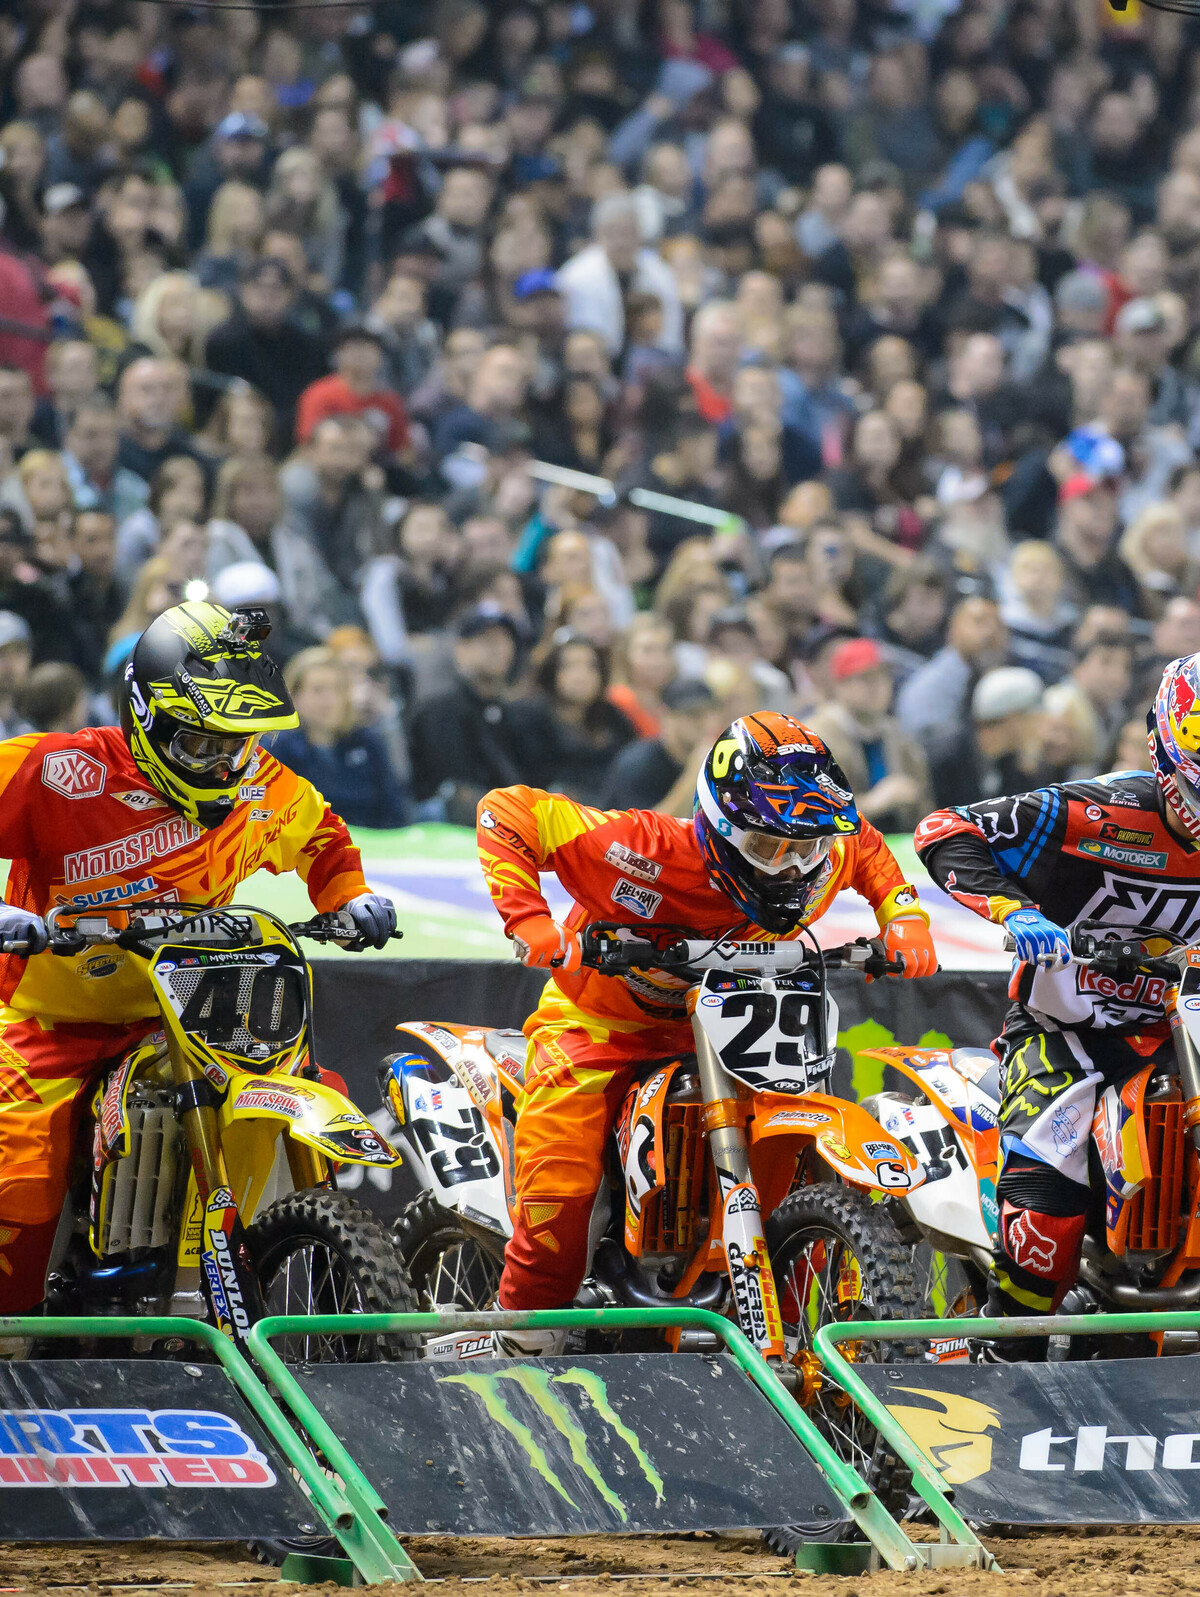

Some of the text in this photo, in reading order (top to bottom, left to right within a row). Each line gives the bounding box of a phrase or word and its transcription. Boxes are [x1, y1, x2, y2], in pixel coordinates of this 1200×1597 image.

[122, 791, 153, 806] BOLT
[1109, 799, 1141, 809] RENTHAL
[1103, 846, 1161, 867] MOTOREX
[73, 877, 154, 908] SUZUKI
[180, 967, 305, 1044] 40
[719, 993, 826, 1070] 29
[202, 1250, 230, 1318] VERTEX
[753, 1238, 778, 1338] PIRELLI
[0, 1413, 249, 1455] RTS
[0, 1457, 270, 1483] IMITED
